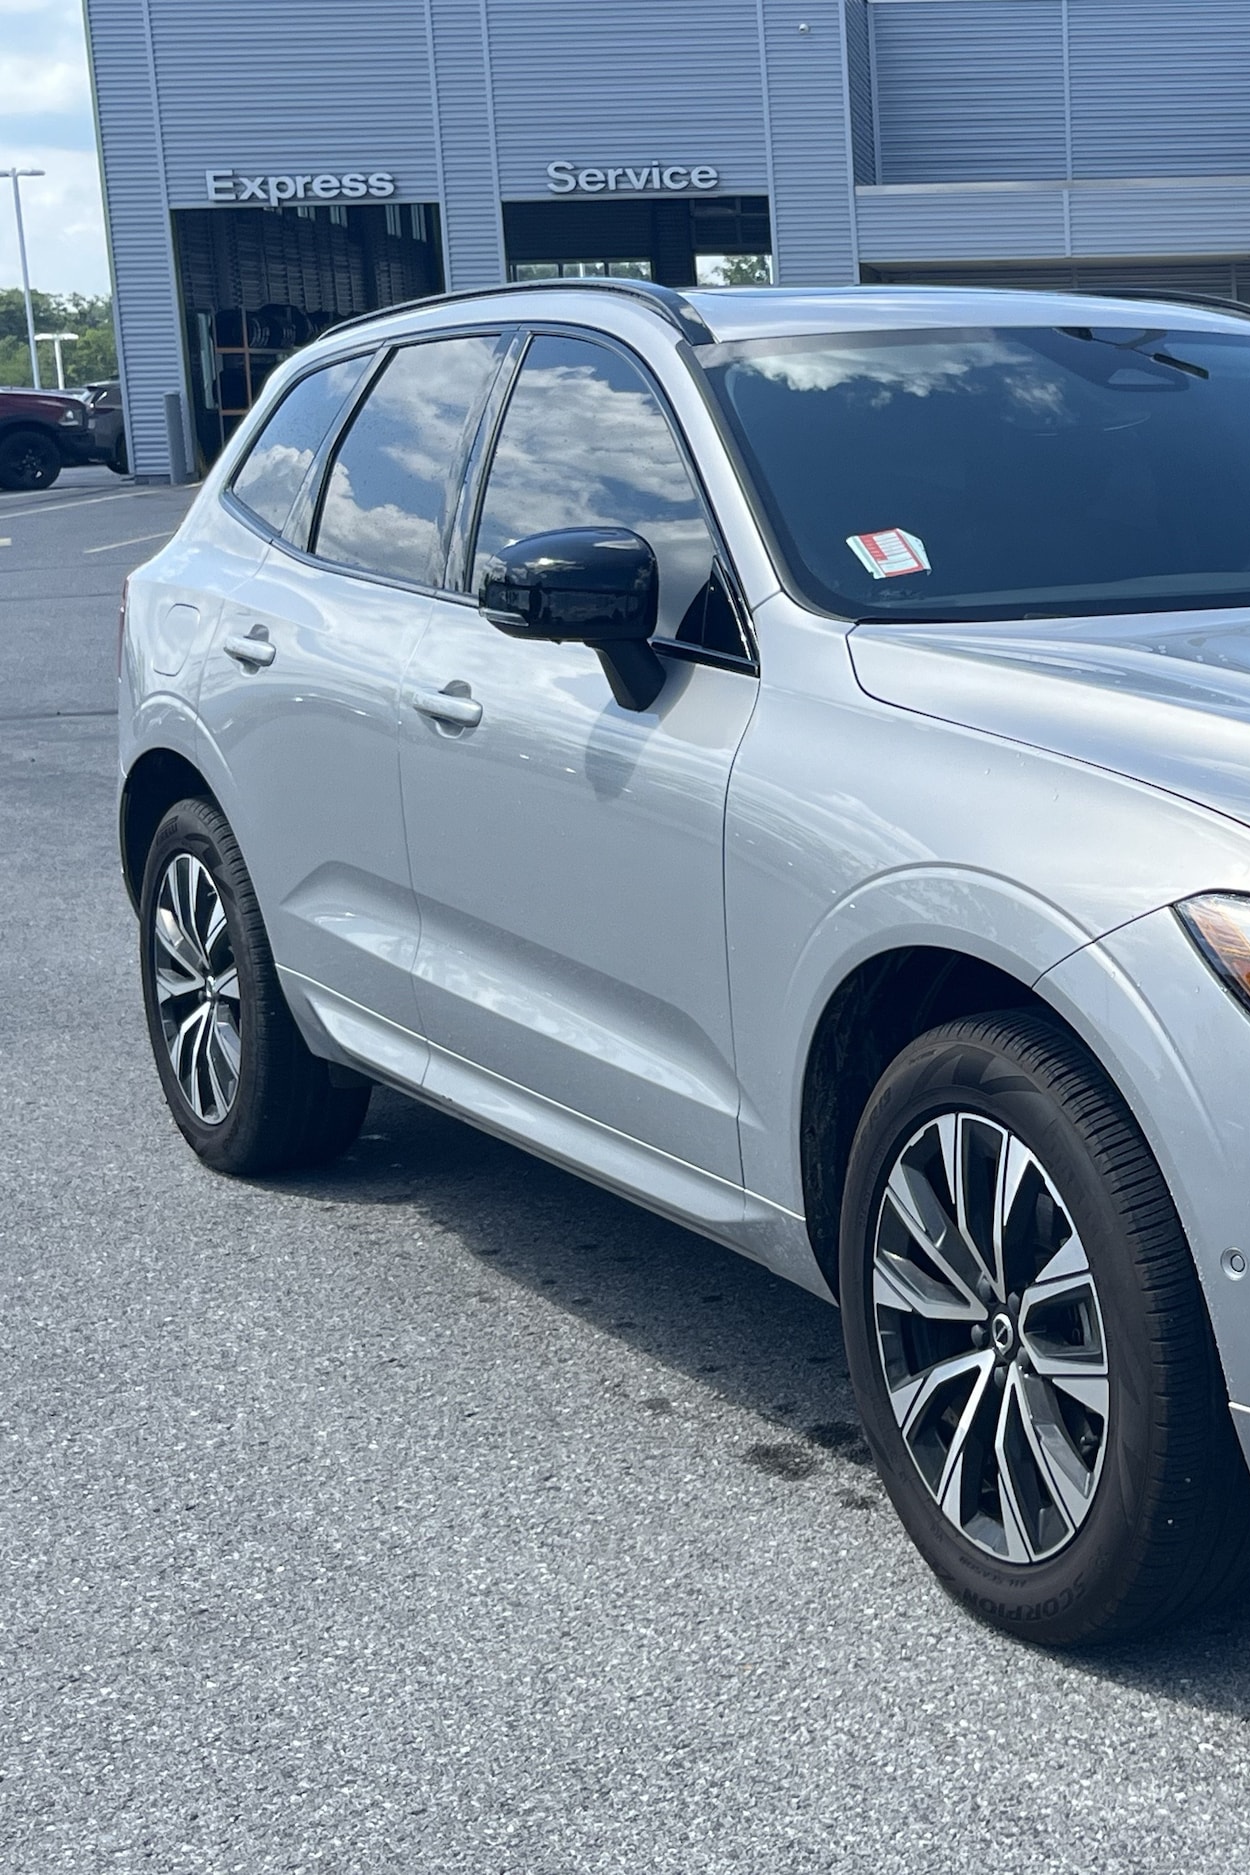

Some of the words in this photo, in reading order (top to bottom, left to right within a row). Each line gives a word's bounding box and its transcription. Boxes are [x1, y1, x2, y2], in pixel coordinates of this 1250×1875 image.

[205, 169, 395, 207] Express
[547, 160, 718, 194] Service
[962, 1571, 1086, 1621] SCORPION
